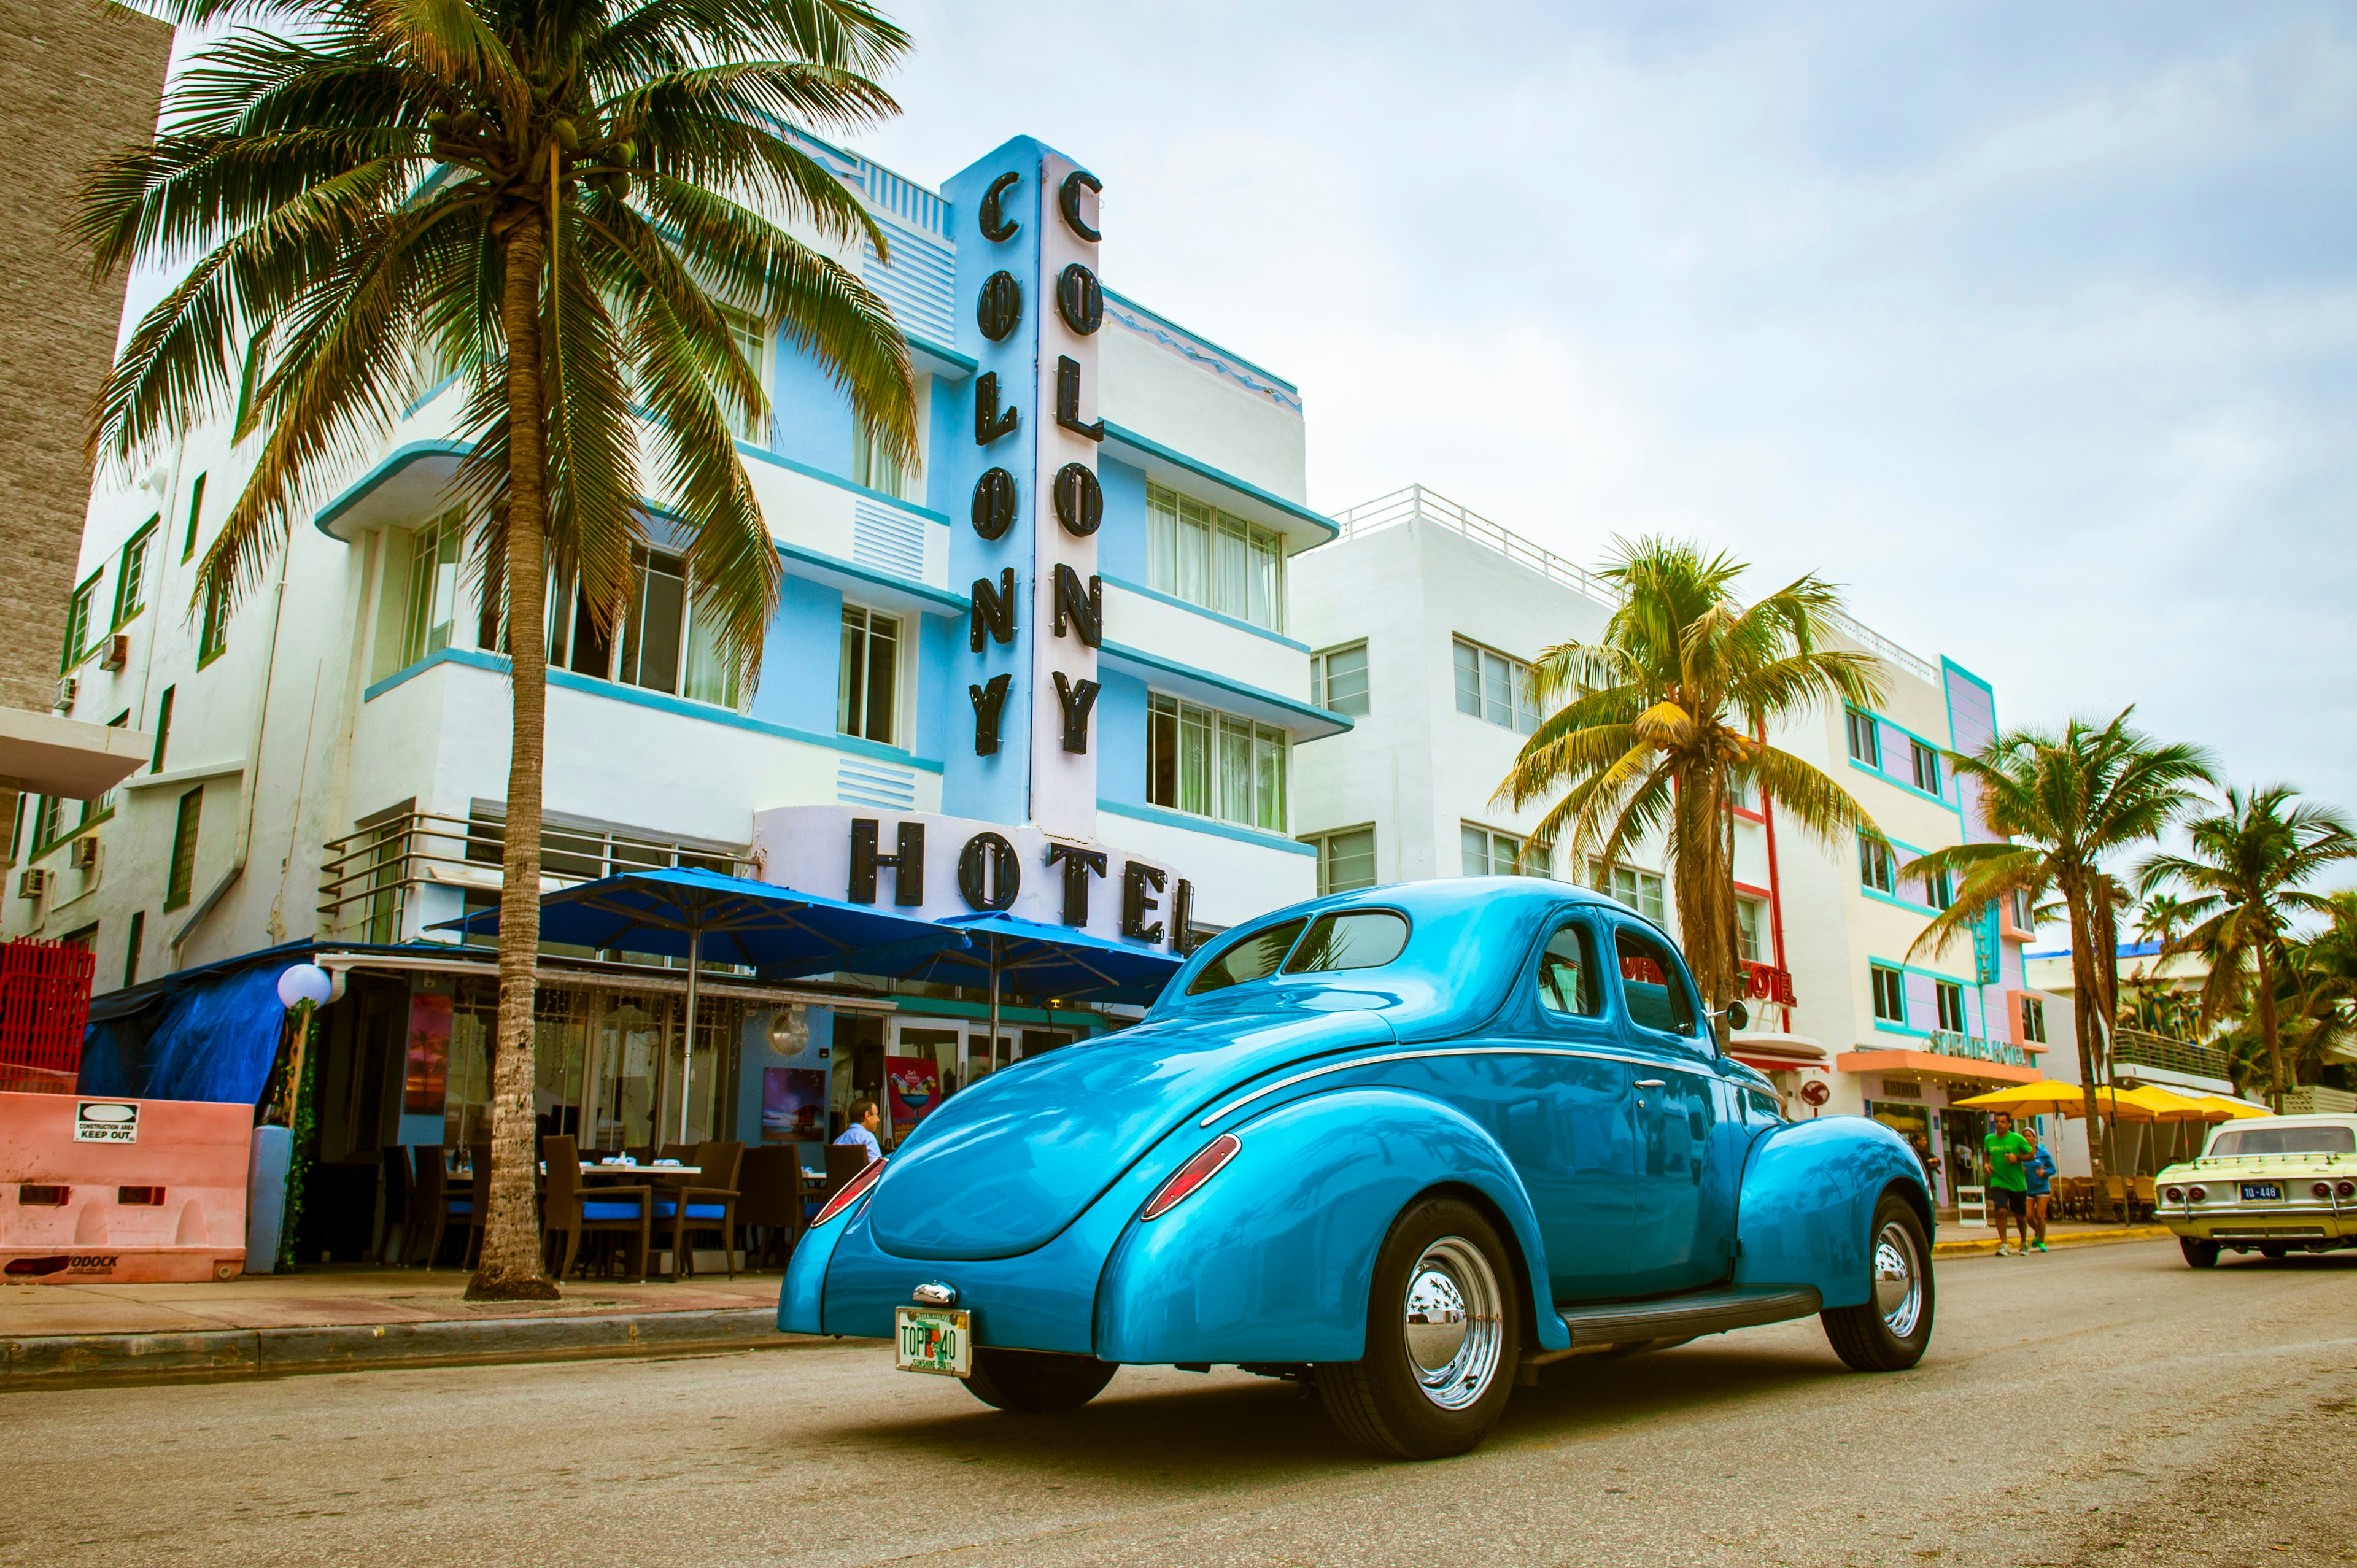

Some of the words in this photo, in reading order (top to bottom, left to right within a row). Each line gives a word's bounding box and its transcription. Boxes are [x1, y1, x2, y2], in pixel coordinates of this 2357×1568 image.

[969, 171, 1022, 756] COLONY
[1052, 171, 1104, 754] COLONY
[848, 818, 1200, 956] HOTEL
[1744, 966, 1798, 1008] OTEL
[1992, 1040, 2027, 1068] HOTEL
[913, 1359, 935, 1369] SUNSHINE
[938, 1361, 952, 1370] STATE
